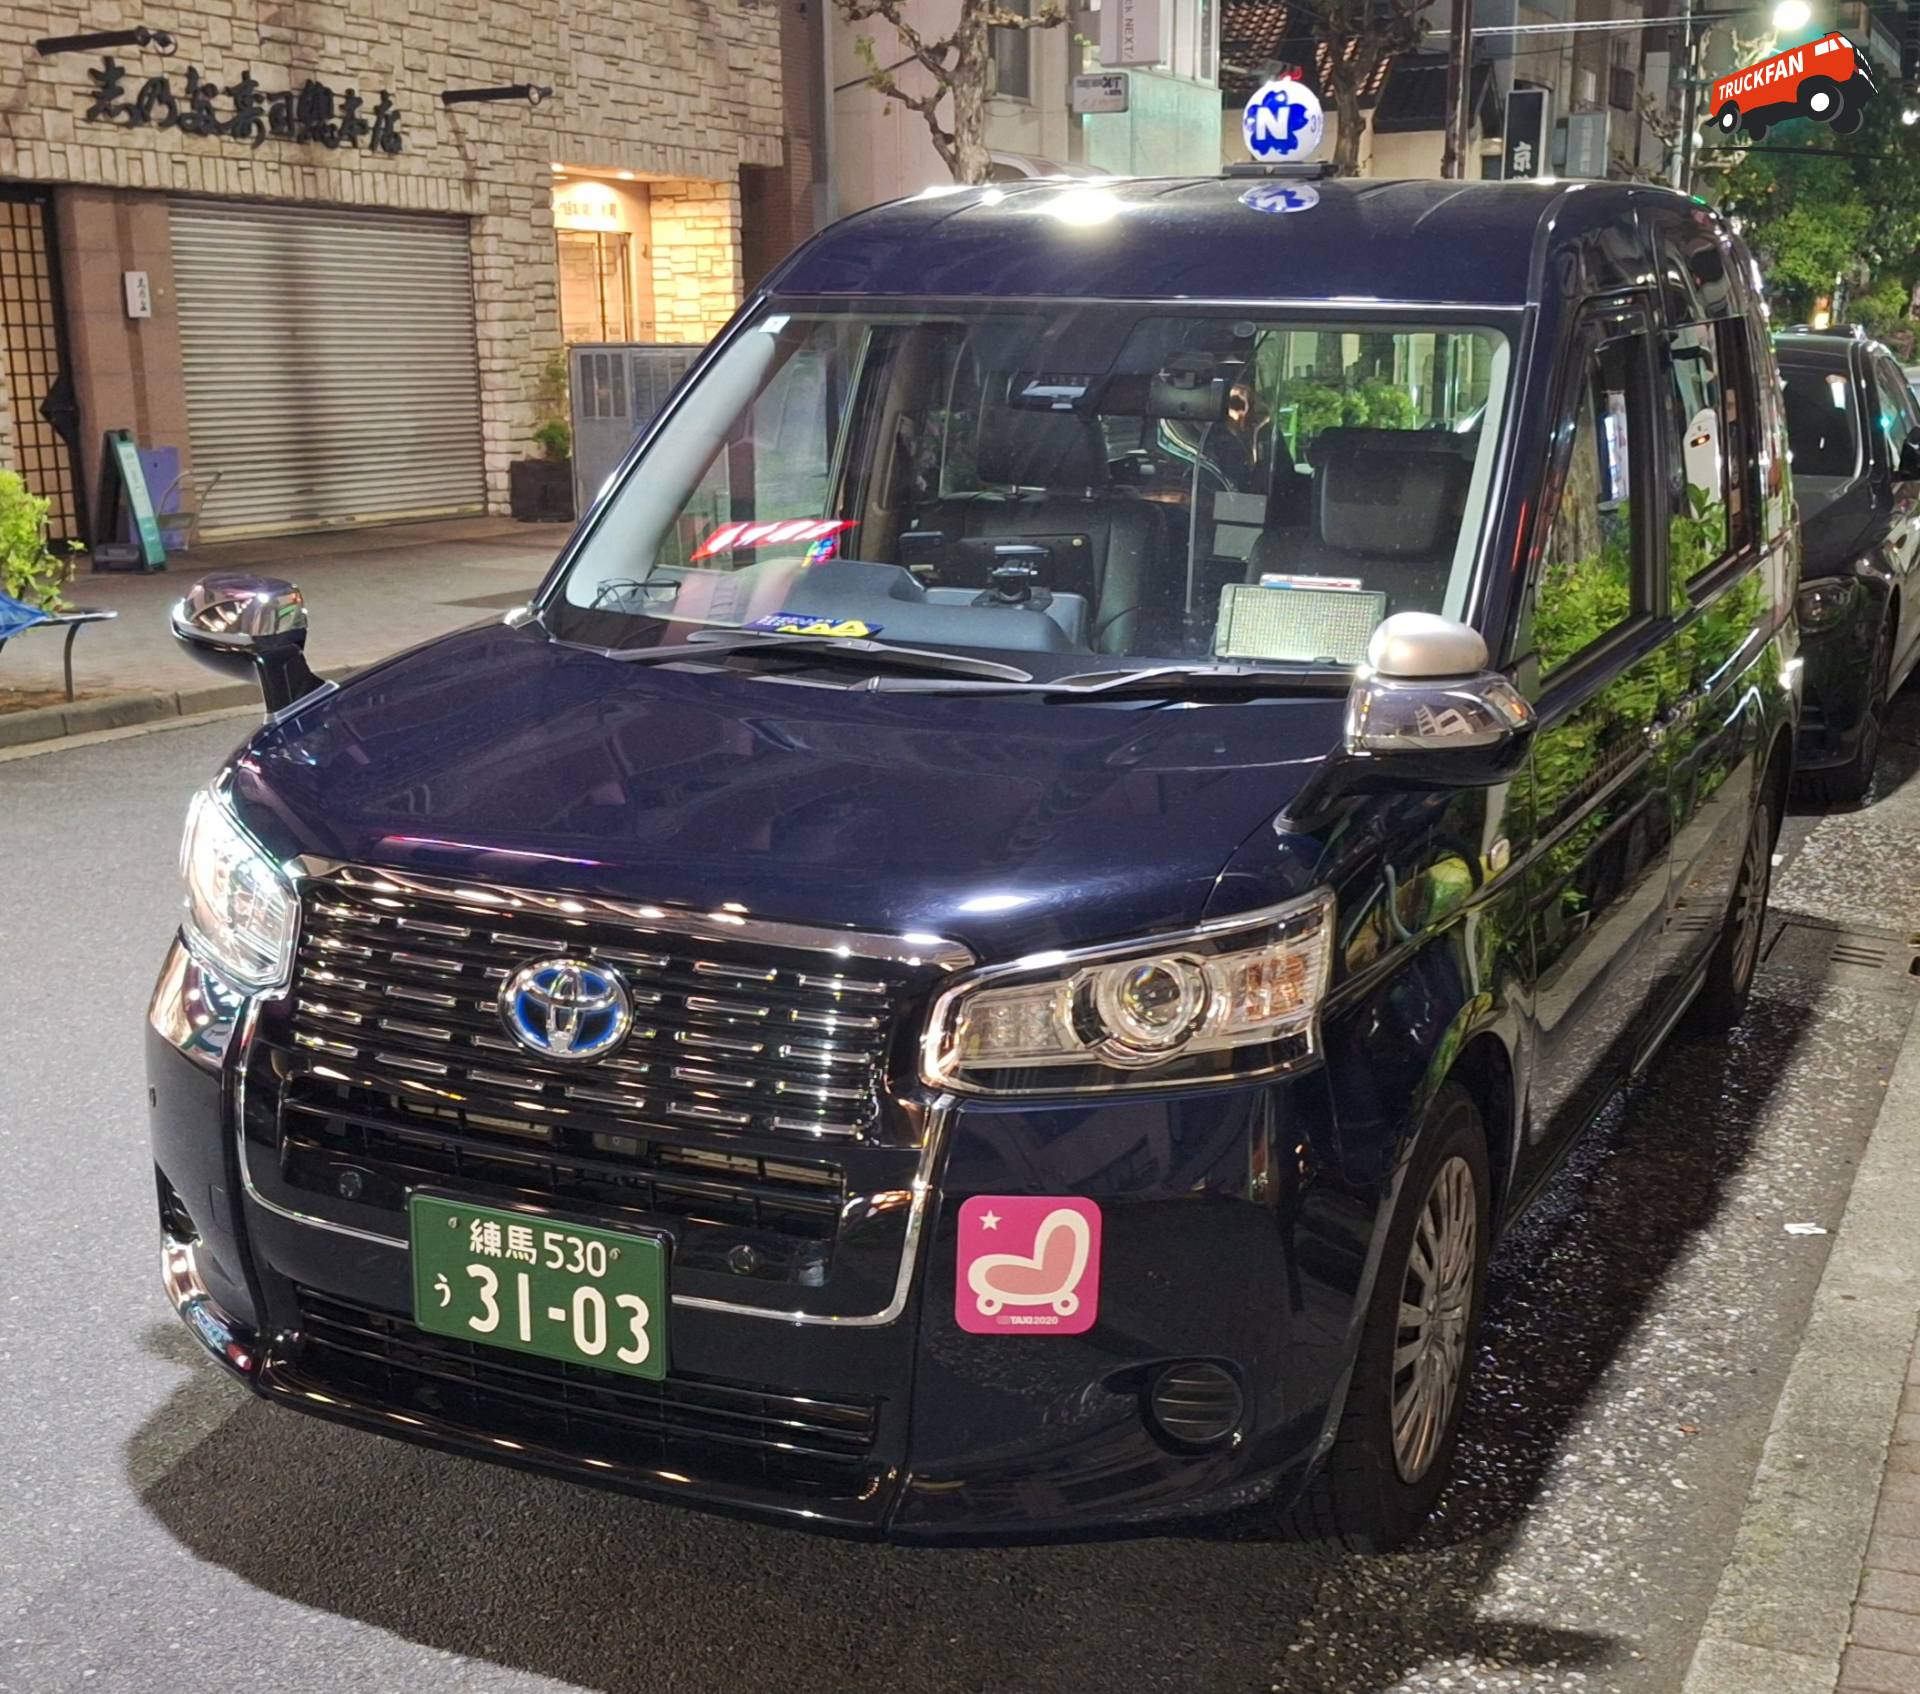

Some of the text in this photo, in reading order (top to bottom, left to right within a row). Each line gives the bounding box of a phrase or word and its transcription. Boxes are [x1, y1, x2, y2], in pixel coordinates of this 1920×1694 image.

[1256, 106, 1291, 140] N
[1513, 140, 1532, 180] 京
[469, 1218, 607, 1278] 練馬 530
[433, 1263, 651, 1365] う 31-03
